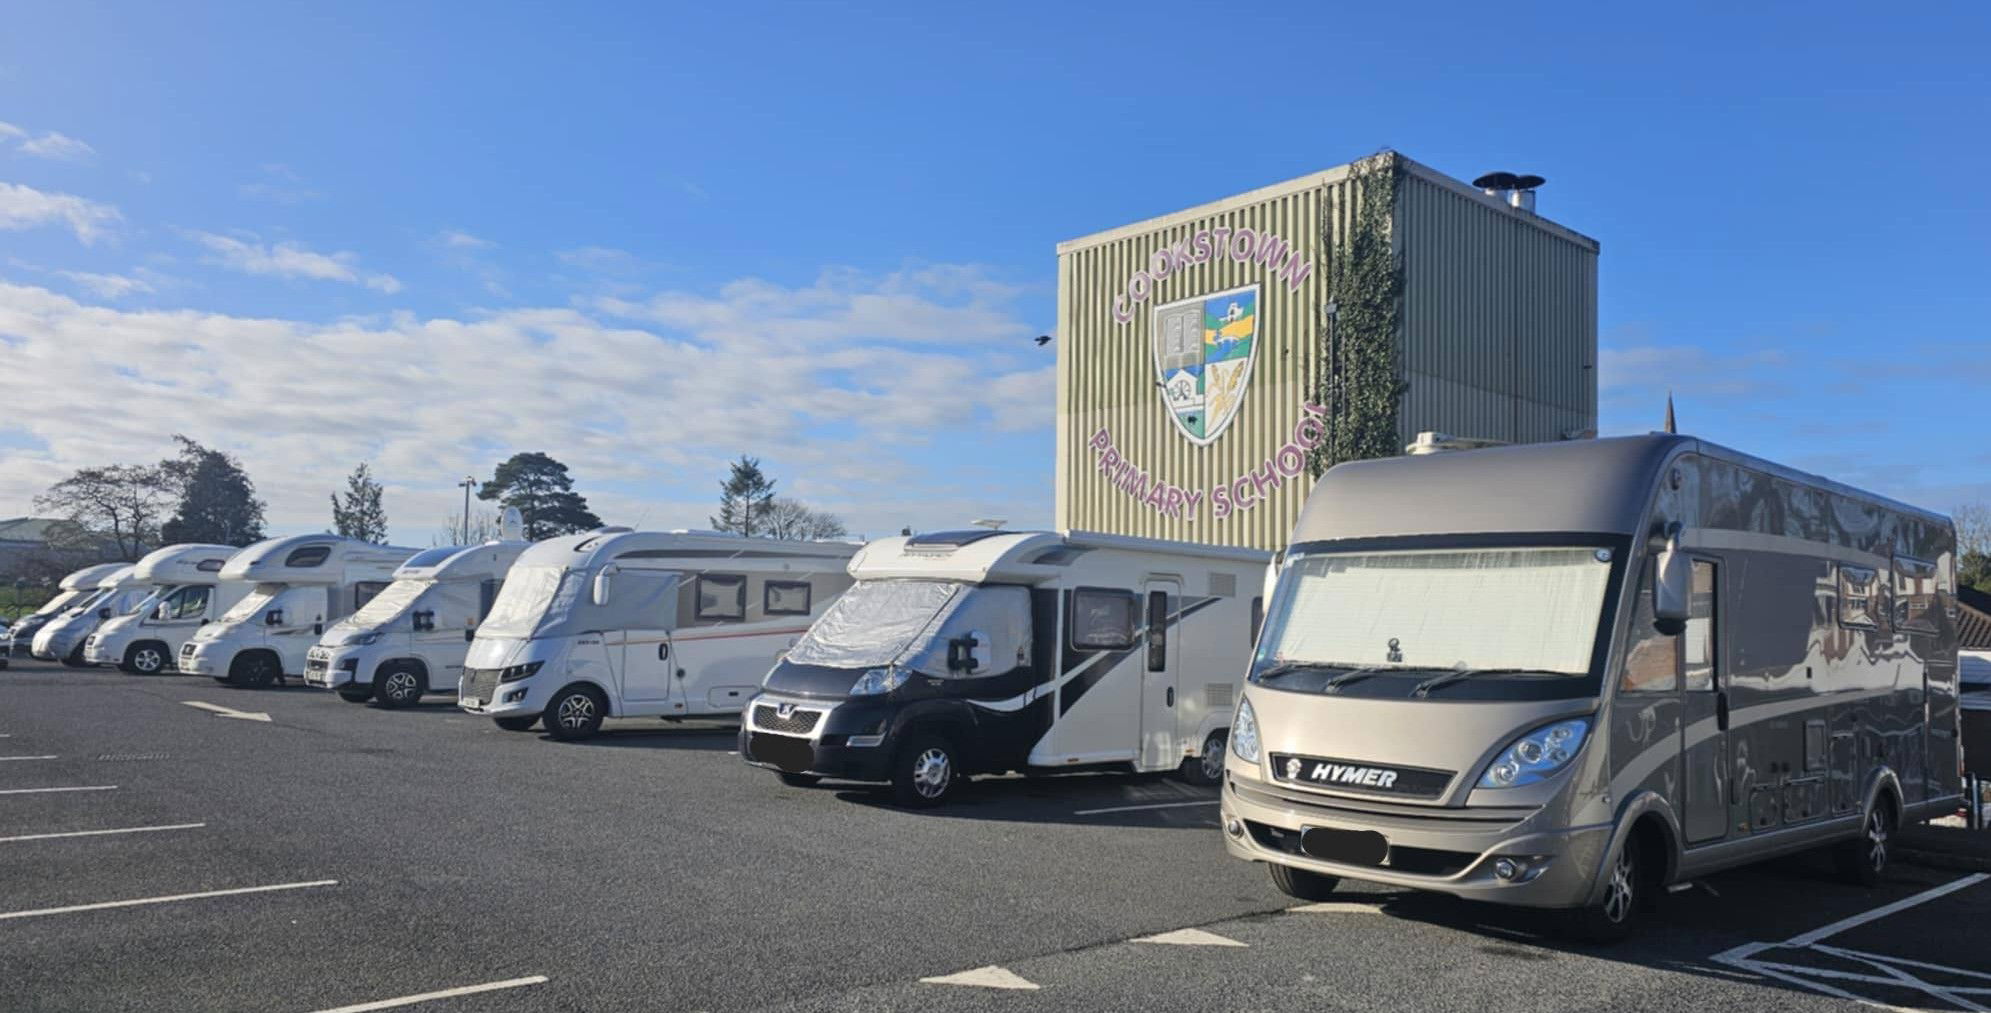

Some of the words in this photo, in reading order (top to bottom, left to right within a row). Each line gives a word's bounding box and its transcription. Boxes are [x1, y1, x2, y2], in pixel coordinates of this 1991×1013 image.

[1113, 227, 1312, 324] COOKSTOWN
[1090, 427, 1203, 520] PRIMARY
[1311, 763, 1398, 788] HYMER
